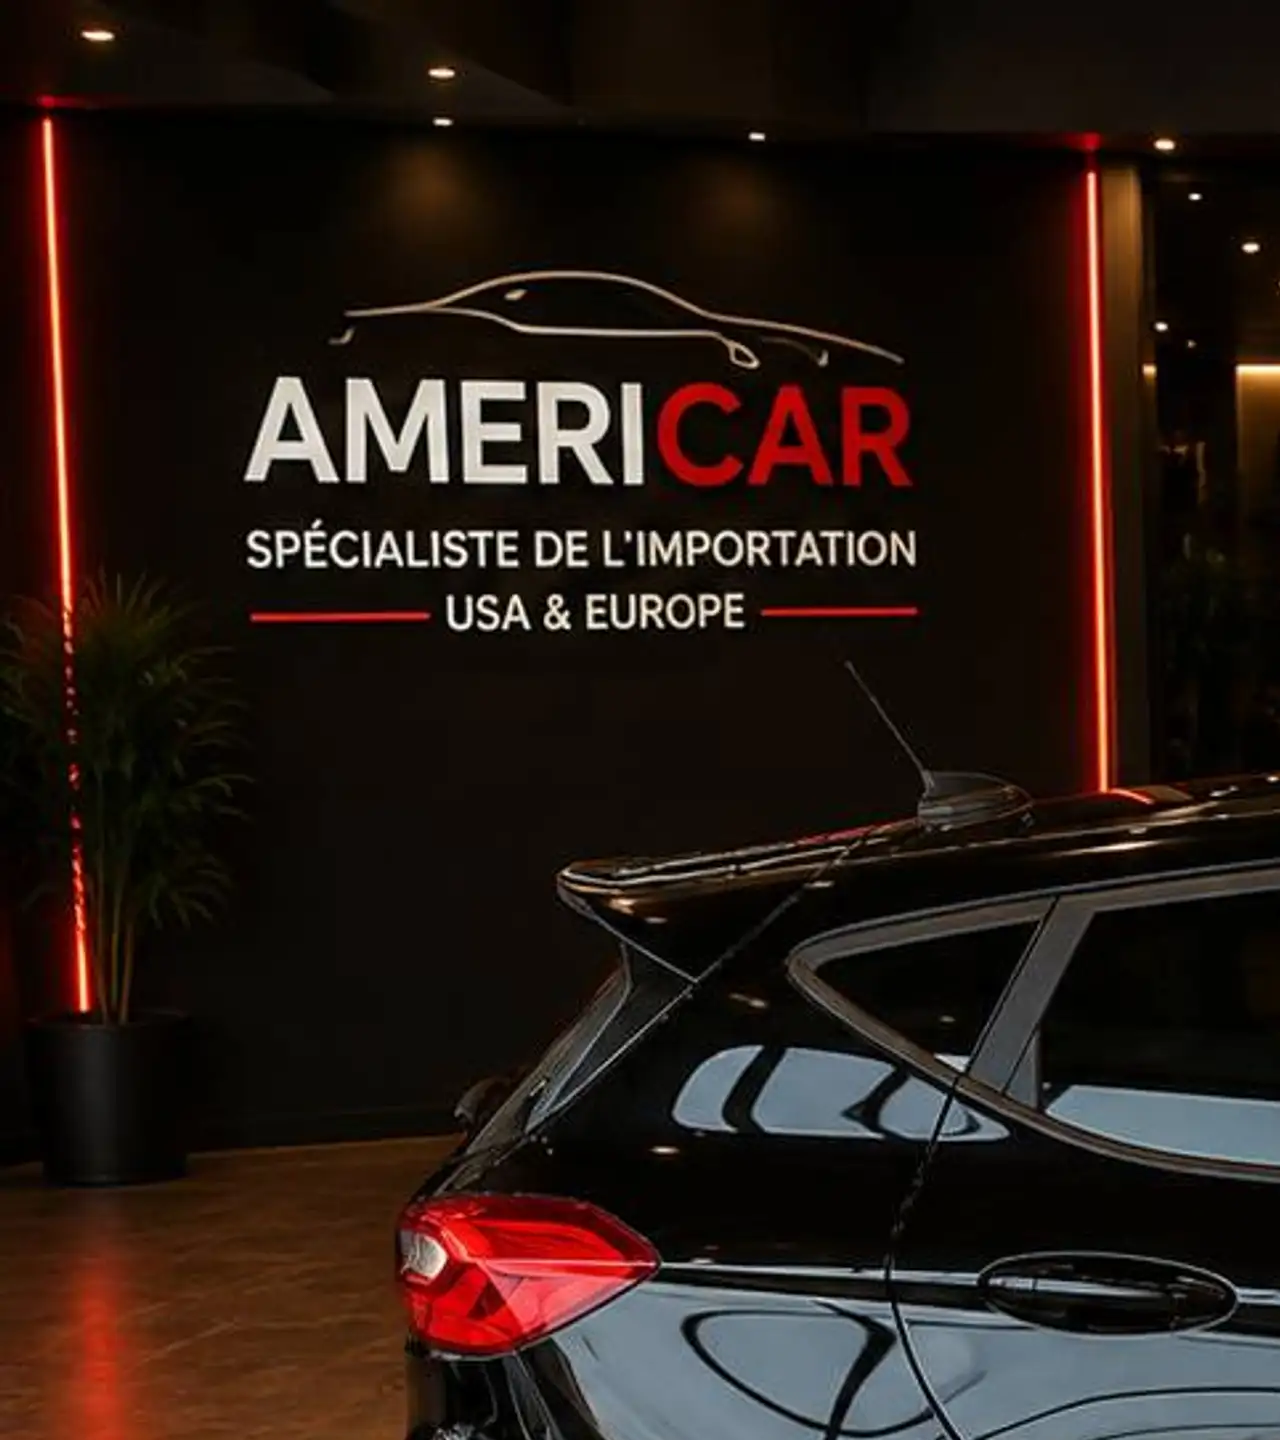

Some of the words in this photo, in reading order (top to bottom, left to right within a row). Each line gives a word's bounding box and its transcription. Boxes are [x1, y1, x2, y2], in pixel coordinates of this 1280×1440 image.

[244, 376, 912, 488] AMERICAR
[246, 519, 520, 570] SPÉCIALISTE
[534, 529, 590, 569] DE
[602, 529, 918, 568] L'IMPORTATION
[445, 594, 532, 632] USA
[543, 594, 572, 631] &
[585, 592, 745, 631] EUROPE
